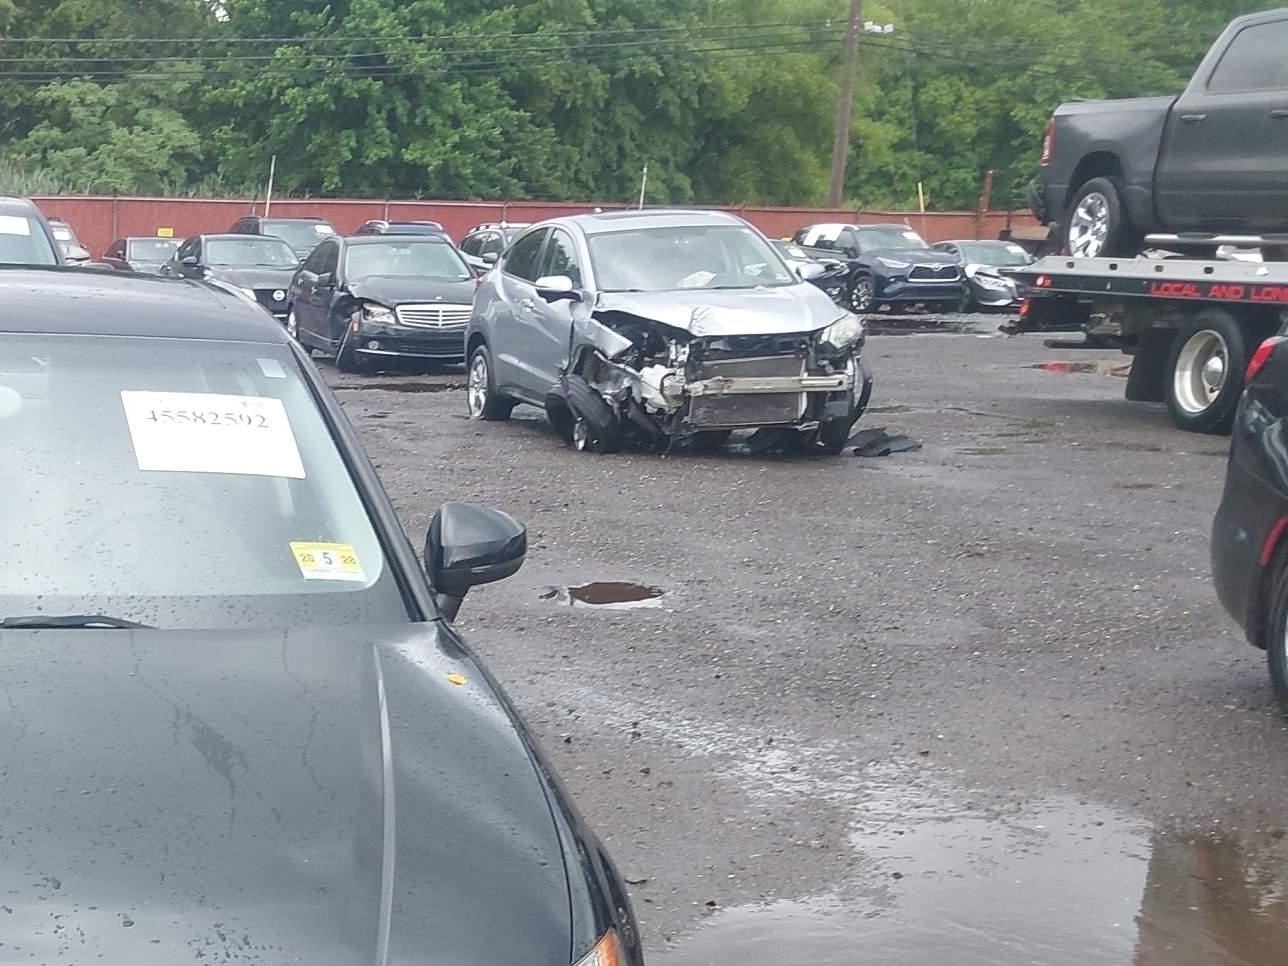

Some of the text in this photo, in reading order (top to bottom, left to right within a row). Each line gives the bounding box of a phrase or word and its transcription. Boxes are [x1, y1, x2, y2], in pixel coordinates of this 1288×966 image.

[1151, 282, 1202, 299] LOCAL
[1208, 284, 1245, 301] AND
[144, 409, 270, 429] 45582592
[322, 551, 333, 565] 5
